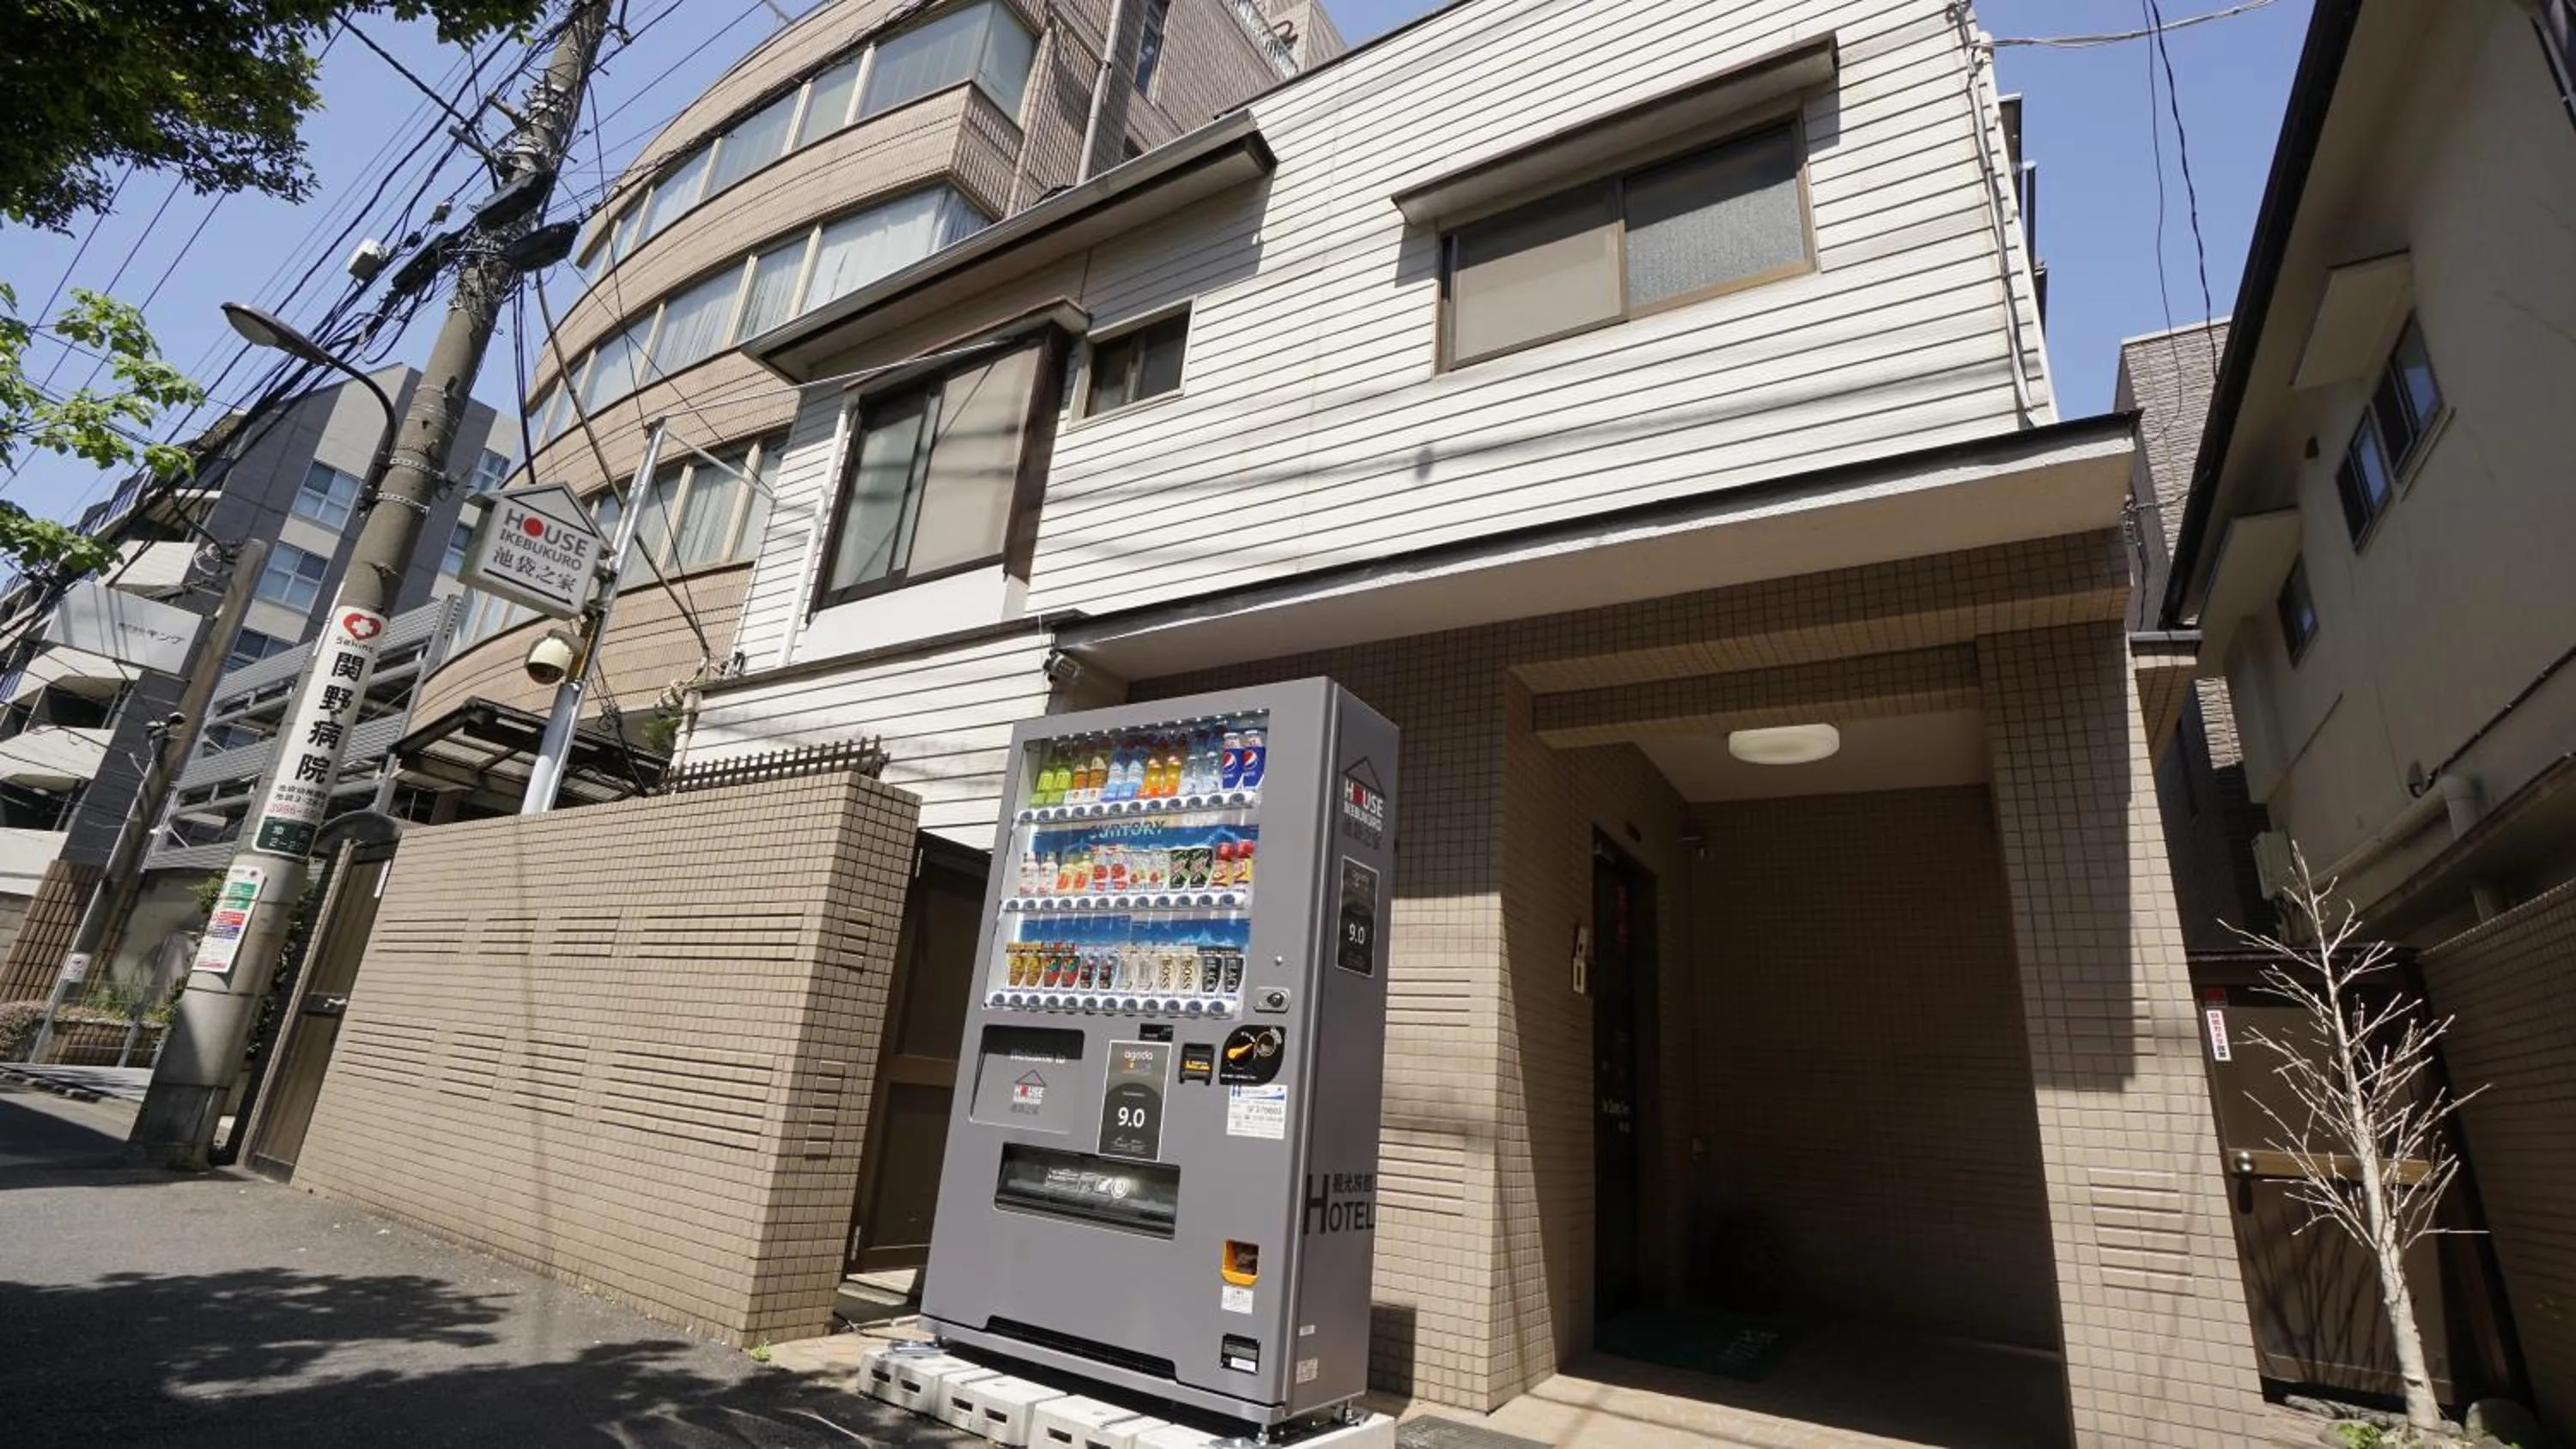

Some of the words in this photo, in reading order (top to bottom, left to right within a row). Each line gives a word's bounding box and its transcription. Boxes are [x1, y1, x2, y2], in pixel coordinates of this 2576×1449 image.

[499, 528, 582, 571] IKEBUKURO
[503, 508, 589, 559] HOUSE
[493, 547, 578, 593] 池袋之家
[295, 652, 366, 785] 関野病院
[1344, 778, 1384, 818] HOUSE
[1088, 819, 1166, 840] SUNTORY
[1348, 923, 1365, 946] 9.0
[1162, 958, 1172, 990] BOSS
[1182, 959, 1193, 990] BOSS
[1124, 1050, 1154, 1064] agoda
[1117, 1106, 1145, 1129] 9.0
[1303, 1173, 1376, 1236] HOTEL
